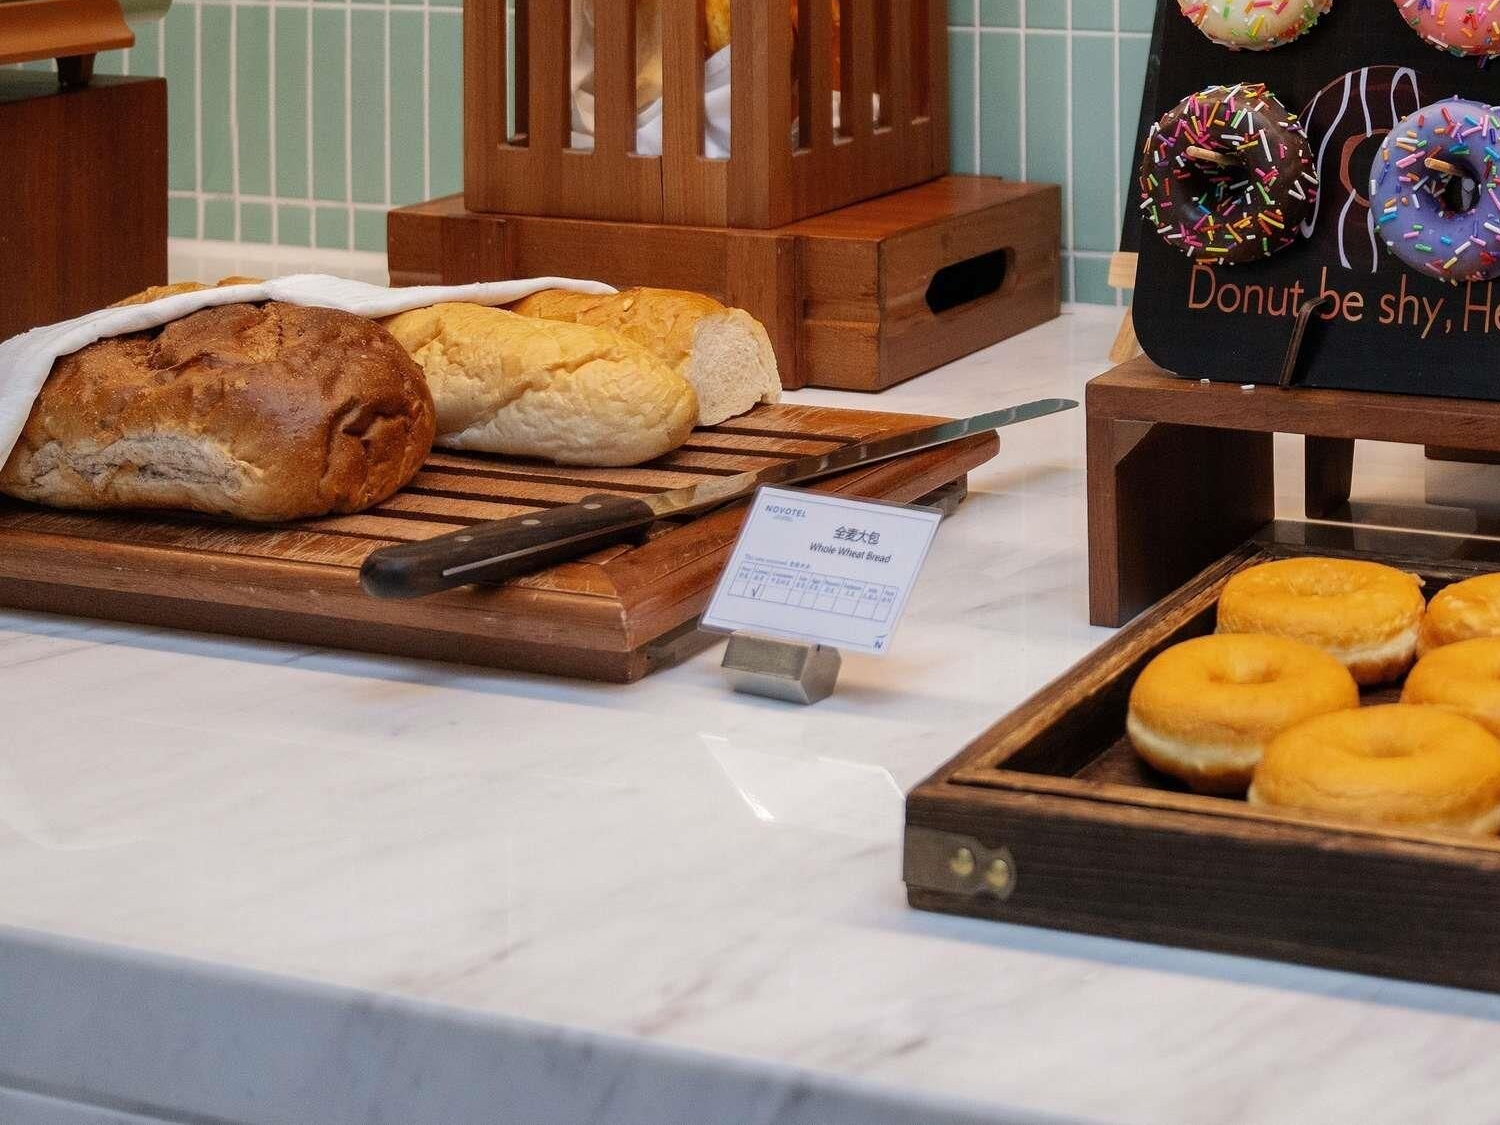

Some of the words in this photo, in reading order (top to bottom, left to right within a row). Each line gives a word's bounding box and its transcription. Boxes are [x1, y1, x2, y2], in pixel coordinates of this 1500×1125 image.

[1187, 264, 1304, 318] Donut
[1319, 266, 1364, 322] be
[1378, 273, 1452, 339] shy,
[764, 503, 807, 519] NOVOTEL
[832, 526, 881, 546] 全麦大包
[809, 542, 838, 556] Whole
[838, 546, 865, 560] Wheat
[865, 550, 892, 564] Bread
